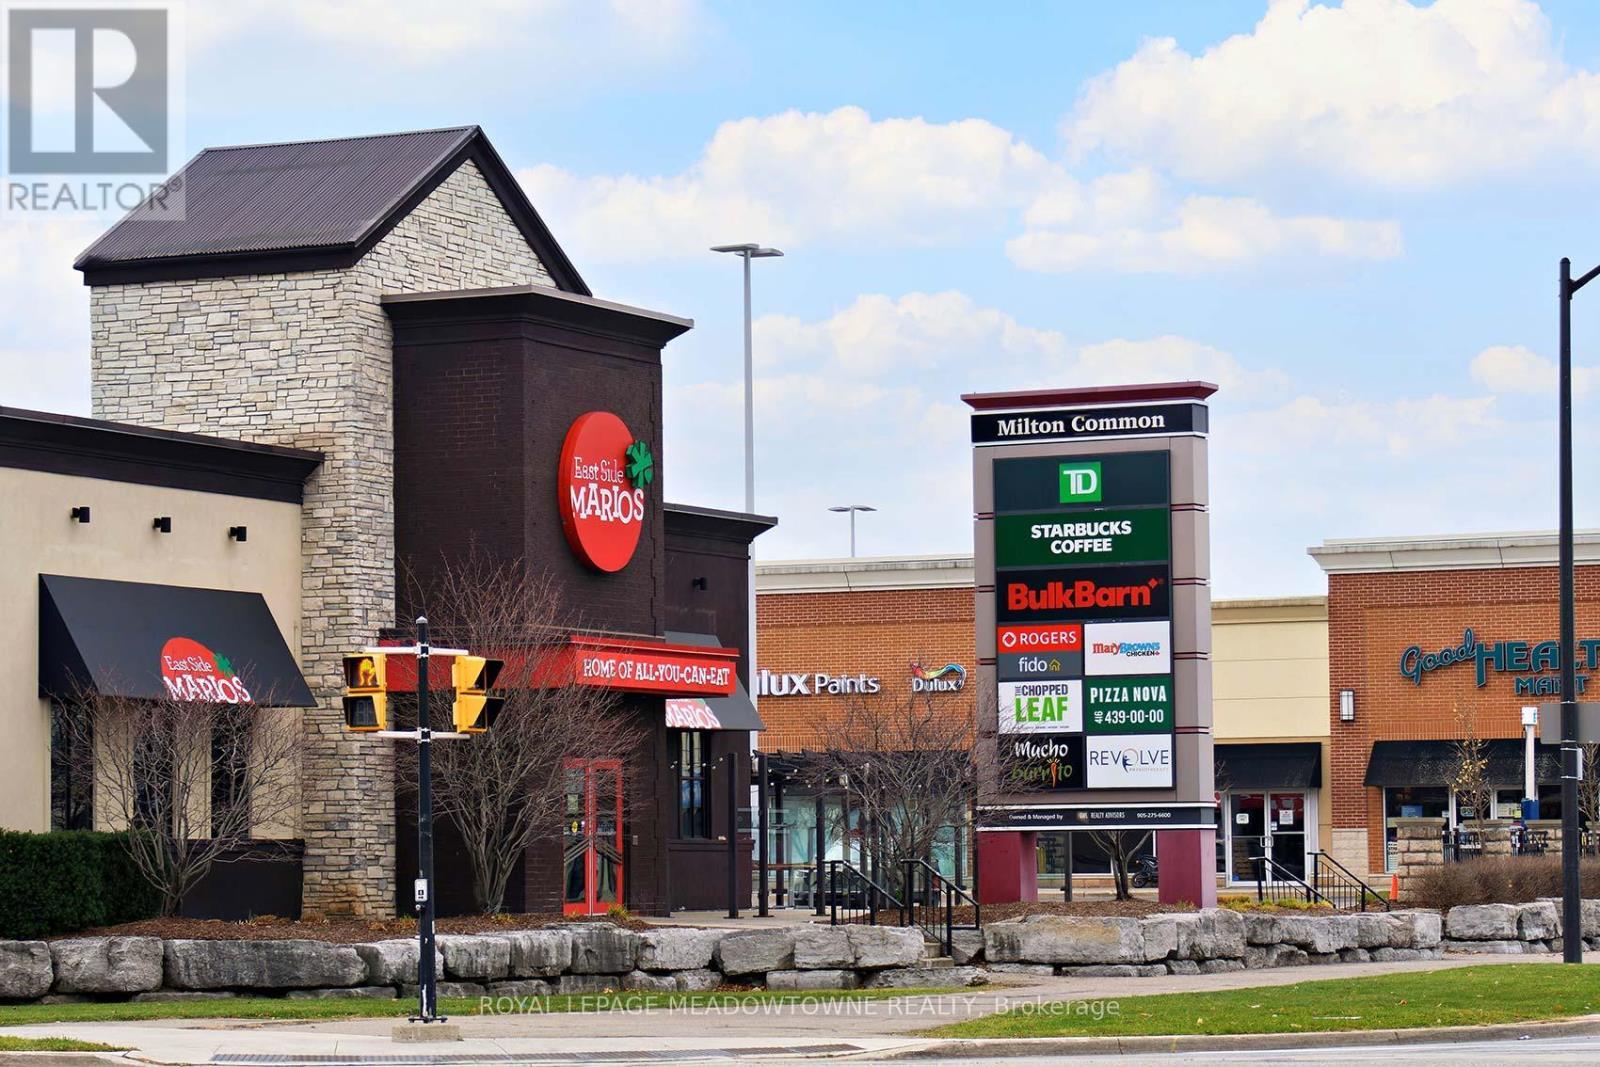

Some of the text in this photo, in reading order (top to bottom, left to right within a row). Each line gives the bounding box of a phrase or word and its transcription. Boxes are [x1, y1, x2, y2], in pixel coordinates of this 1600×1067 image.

[997, 414, 1165, 437] Milton Common
[574, 457, 624, 483] East Side
[1063, 469, 1097, 495] TD
[570, 483, 644, 524] MARIOS
[1031, 520, 1132, 538] STARBUCKS
[1051, 538, 1112, 554] COFFEE
[1008, 580, 1151, 611] BulkBarn
[1019, 632, 1077, 646] ROGERS
[164, 655, 213, 672] East Side
[1018, 657, 1047, 673] fido
[1400, 627, 1600, 687] Good HEAT
[583, 658, 730, 687] HOME OF ALL-YOU-CAN-EAT
[163, 674, 251, 704] MARIOS
[757, 670, 880, 696] lux Paints
[913, 677, 958, 692] Dulux
[1022, 684, 1068, 696] CHOPPED
[1090, 685, 1167, 703] PIZZA NOVA
[1015, 696, 1068, 722] LEAF
[1094, 709, 1164, 724] 416 439-00-00
[1014, 738, 1069, 758] Mucho
[1090, 748, 1169, 768] REVOLVE
[1032, 813, 1055, 821] Managed
